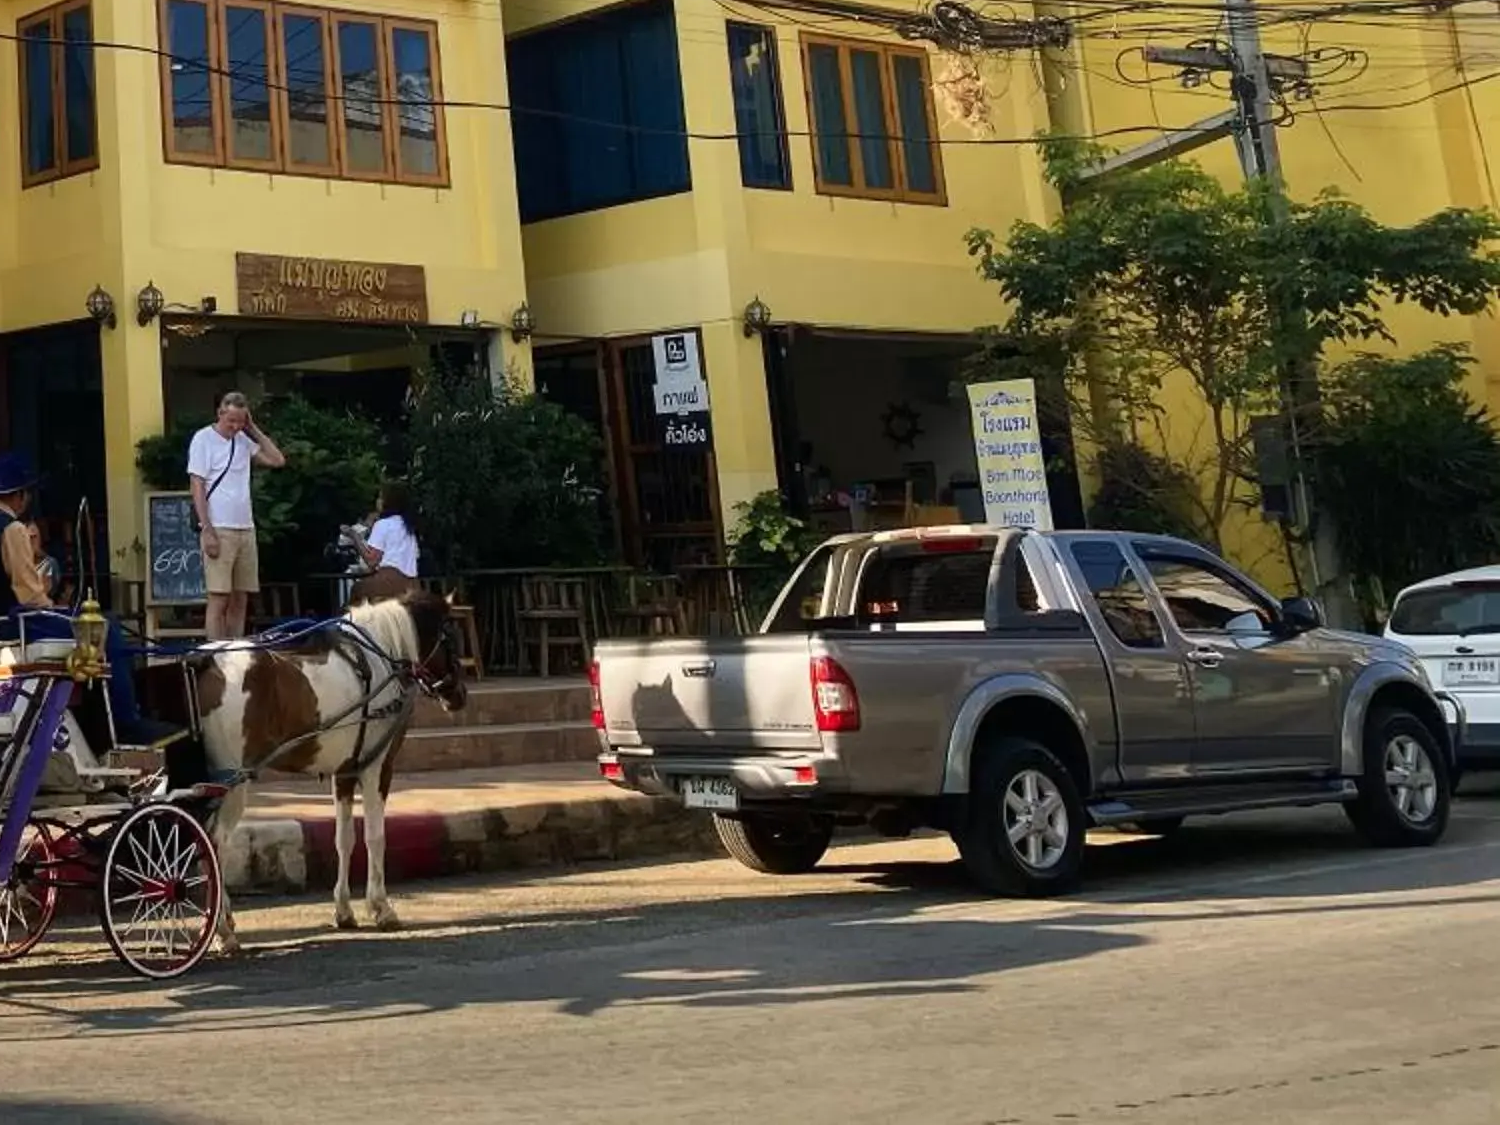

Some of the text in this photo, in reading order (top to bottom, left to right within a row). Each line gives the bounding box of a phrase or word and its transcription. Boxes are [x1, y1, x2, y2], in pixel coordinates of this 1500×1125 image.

[663, 385, 699, 407] กาแฟ
[665, 419, 707, 444] คั่วโอ่ง
[980, 410, 1031, 434] โรงแรม
[985, 489, 1047, 505] Boonthong
[1002, 508, 1036, 526] Hotel
